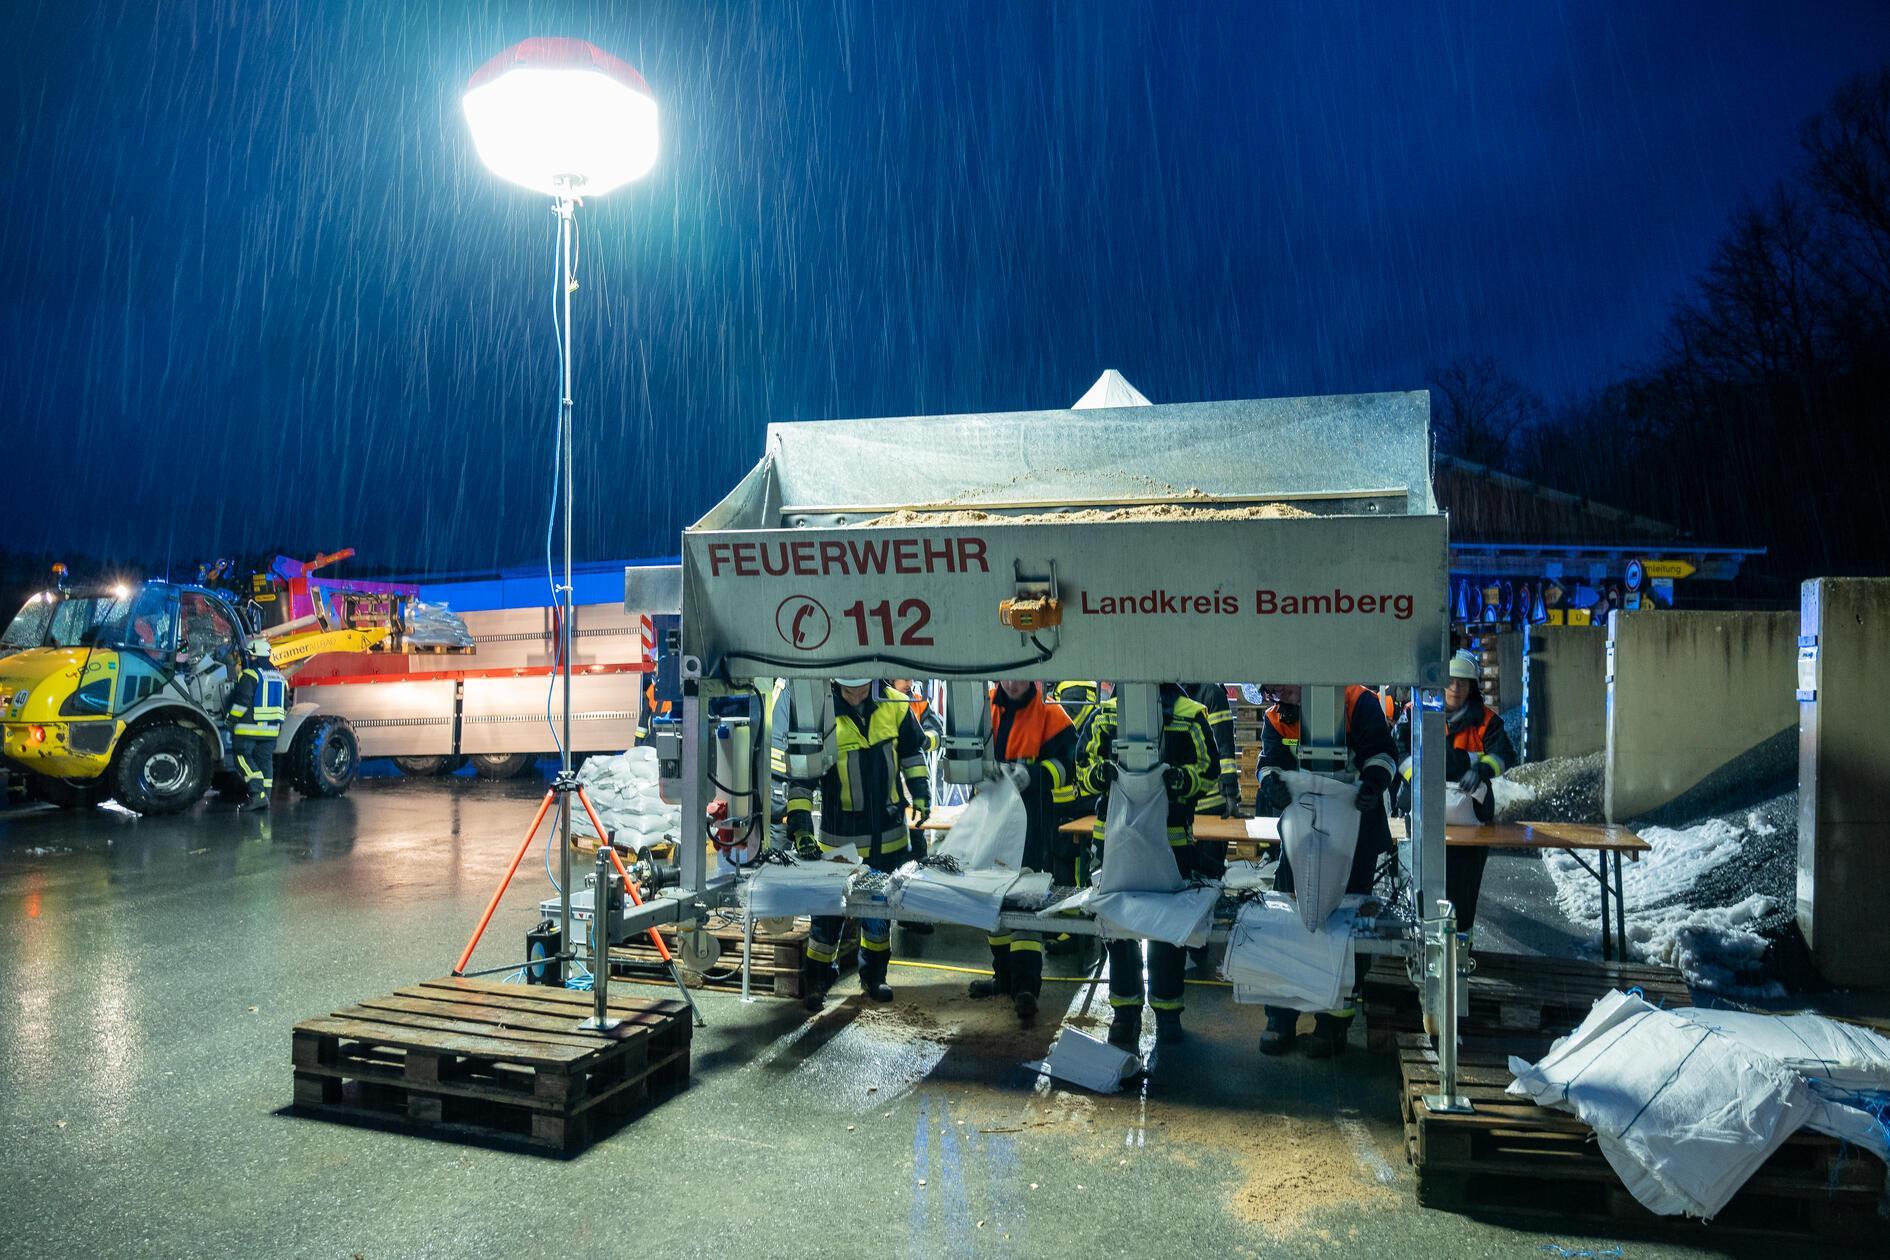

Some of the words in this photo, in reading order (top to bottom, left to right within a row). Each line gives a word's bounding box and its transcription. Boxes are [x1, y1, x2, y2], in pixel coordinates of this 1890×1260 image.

[708, 537, 990, 577] FEUERWEHR
[1081, 590, 1239, 615] Landkreis
[1256, 589, 1414, 620] Bamberg
[844, 599, 934, 647] 112
[272, 644, 309, 662] kramer
